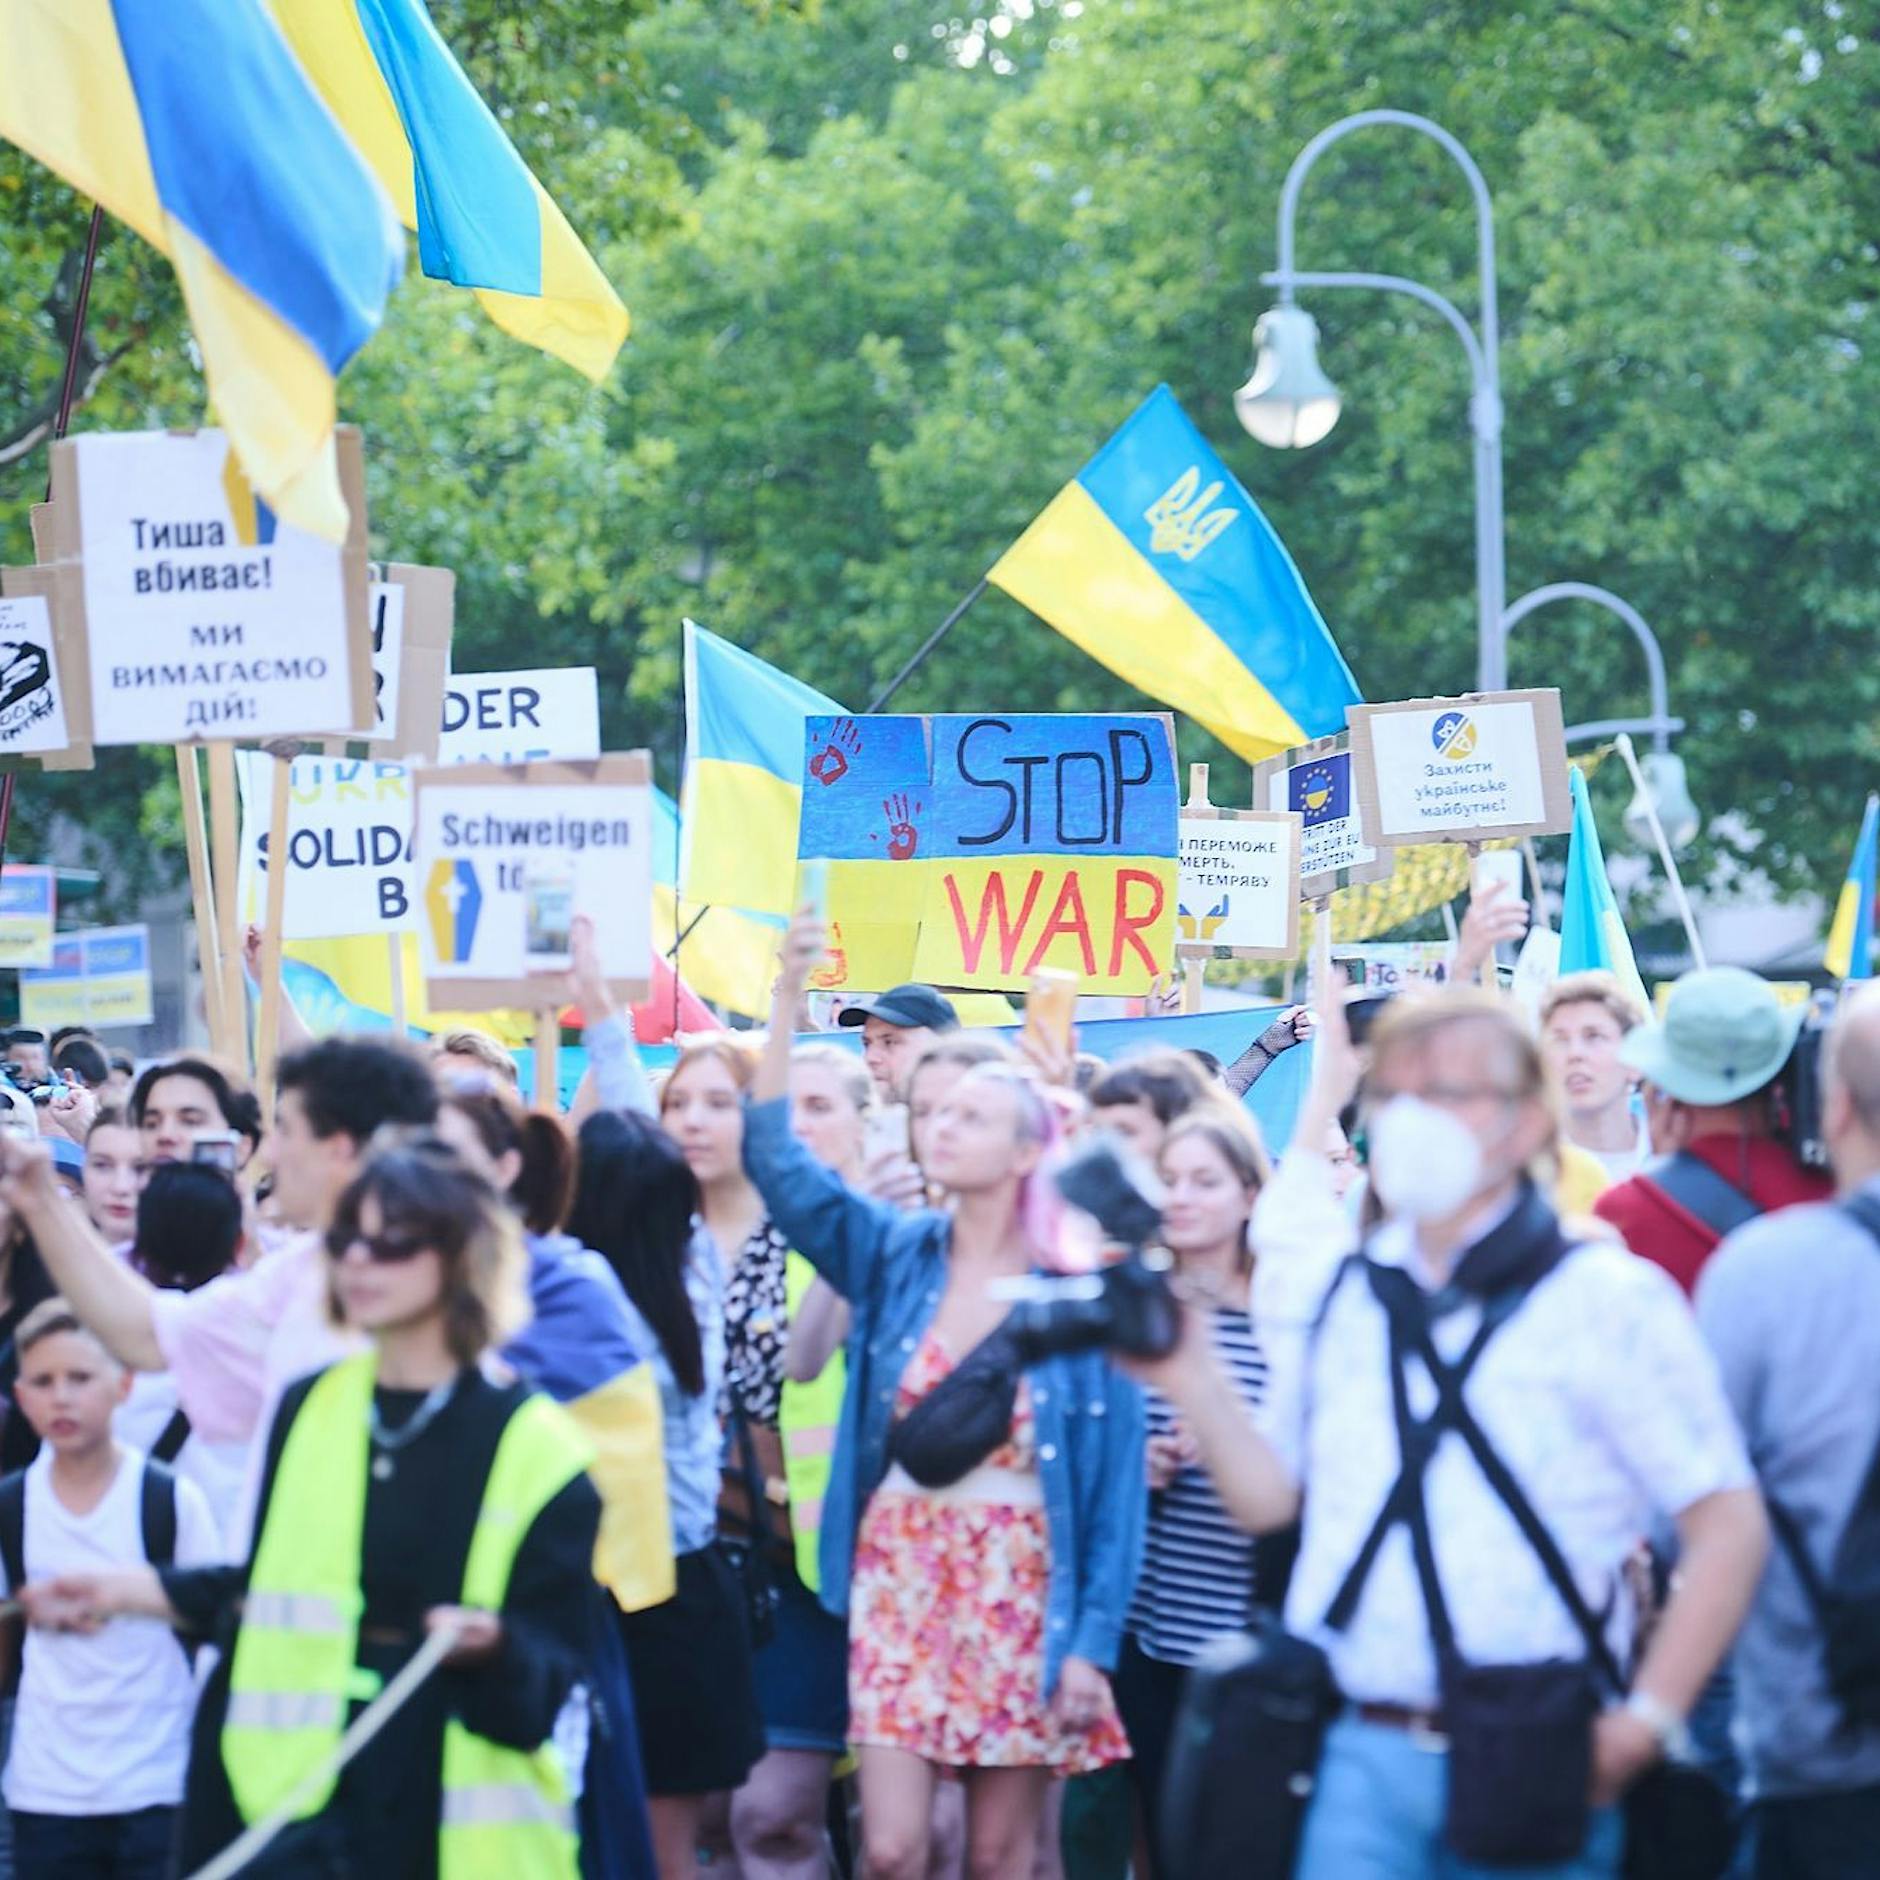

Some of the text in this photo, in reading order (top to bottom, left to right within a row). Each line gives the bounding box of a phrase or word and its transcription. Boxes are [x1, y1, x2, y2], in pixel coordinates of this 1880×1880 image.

[131, 518, 225, 549] Тиша
[134, 556, 273, 594] вбиває!
[111, 656, 328, 689] ВИМАГАЄМО
[185, 690, 257, 726] ДІЙ!
[957, 719, 1153, 845] STOP
[1424, 762, 1494, 777] Захисти
[1414, 779, 1508, 801] українське
[1420, 798, 1507, 818] майбутнє!
[257, 825, 413, 871] OLID
[441, 813, 631, 851] Schweigen
[1188, 839, 1278, 853] ПЕРЕМОЖЕ
[1197, 874, 1270, 888] ТЕМРЯВУ
[944, 869, 1163, 977] WAR
